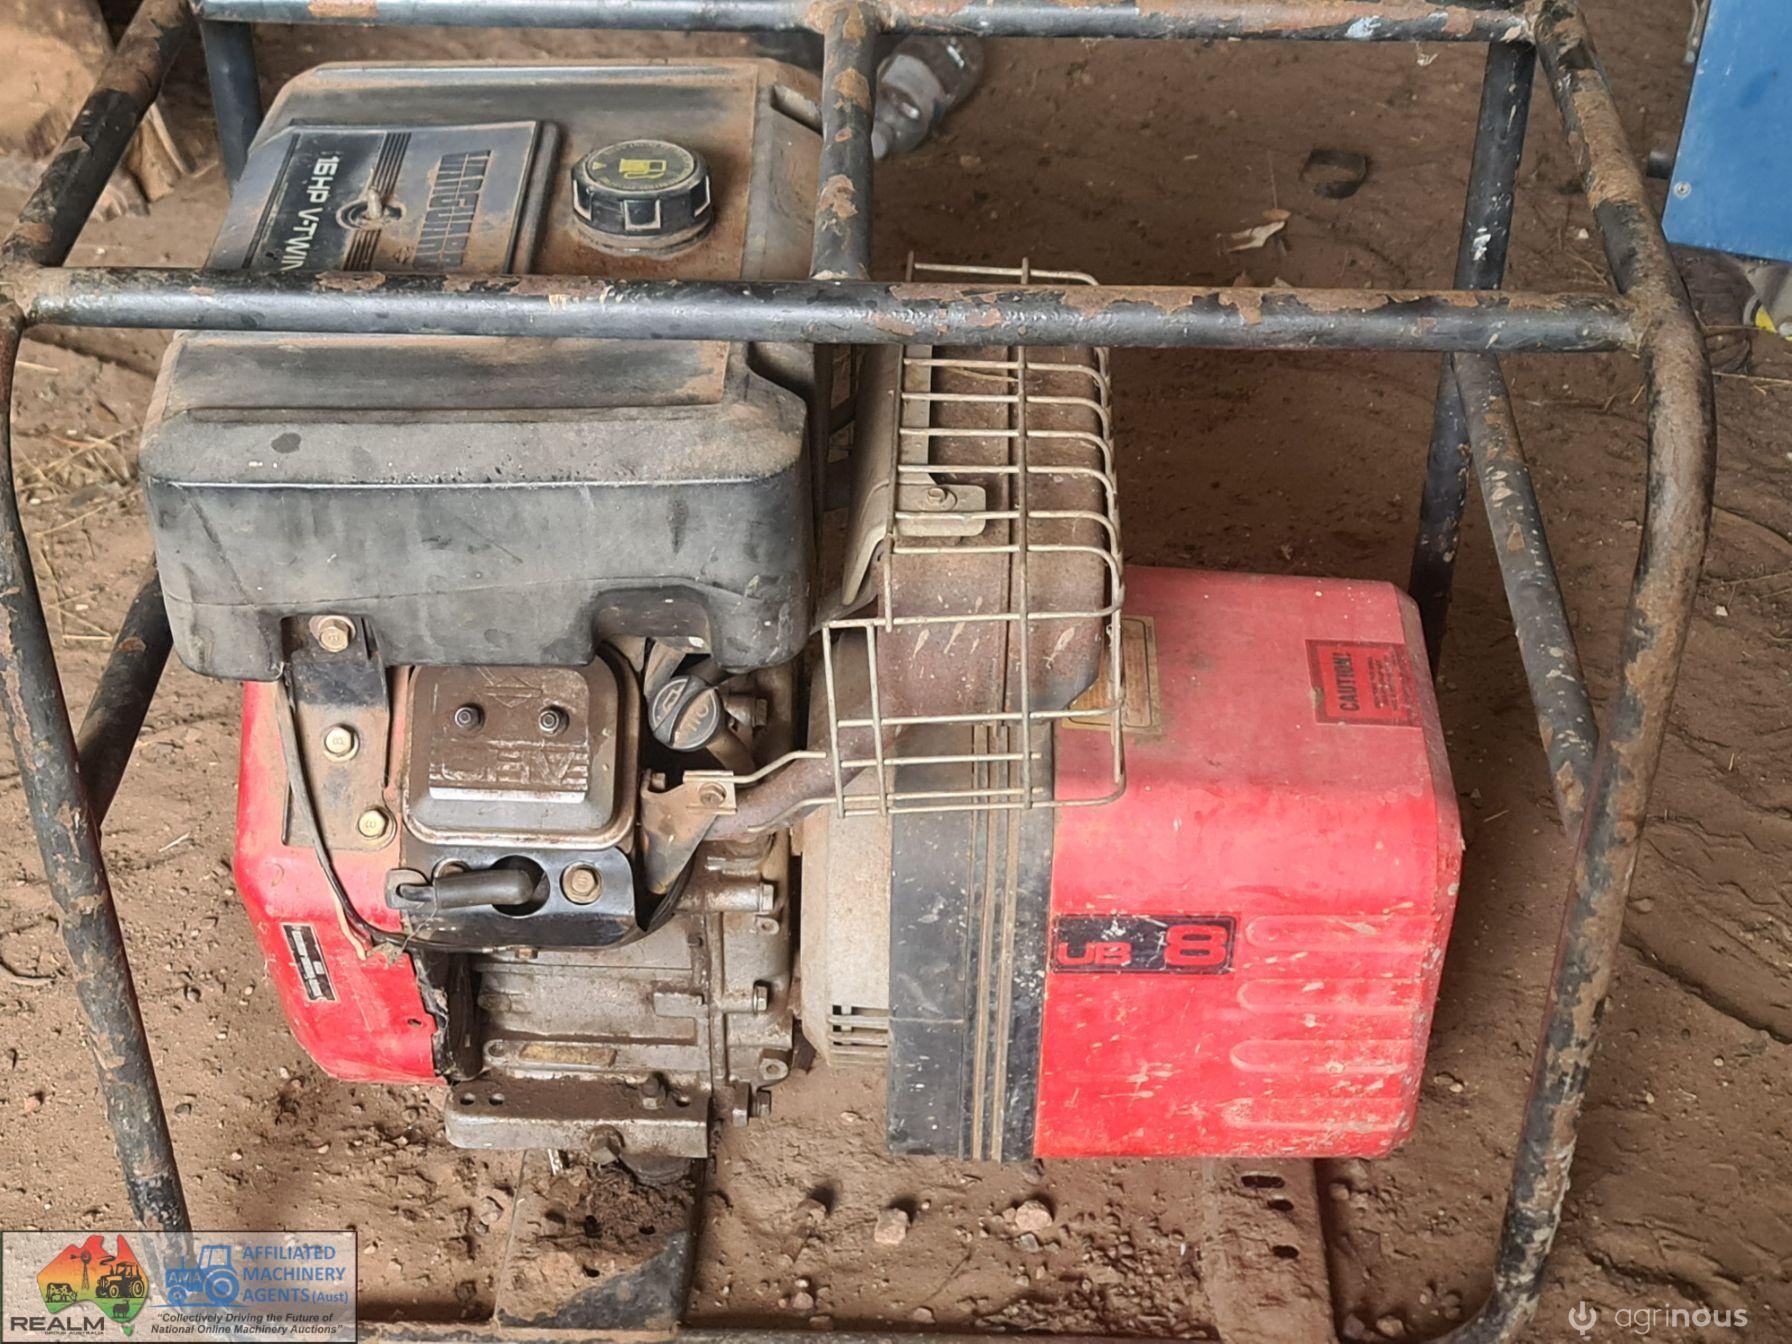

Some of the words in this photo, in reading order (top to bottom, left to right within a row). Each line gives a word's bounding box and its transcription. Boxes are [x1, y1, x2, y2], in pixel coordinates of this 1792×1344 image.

[306, 154, 341, 204] 16HP
[1332, 651, 1360, 712] CAUTION!
[1163, 924, 1229, 967] 8
